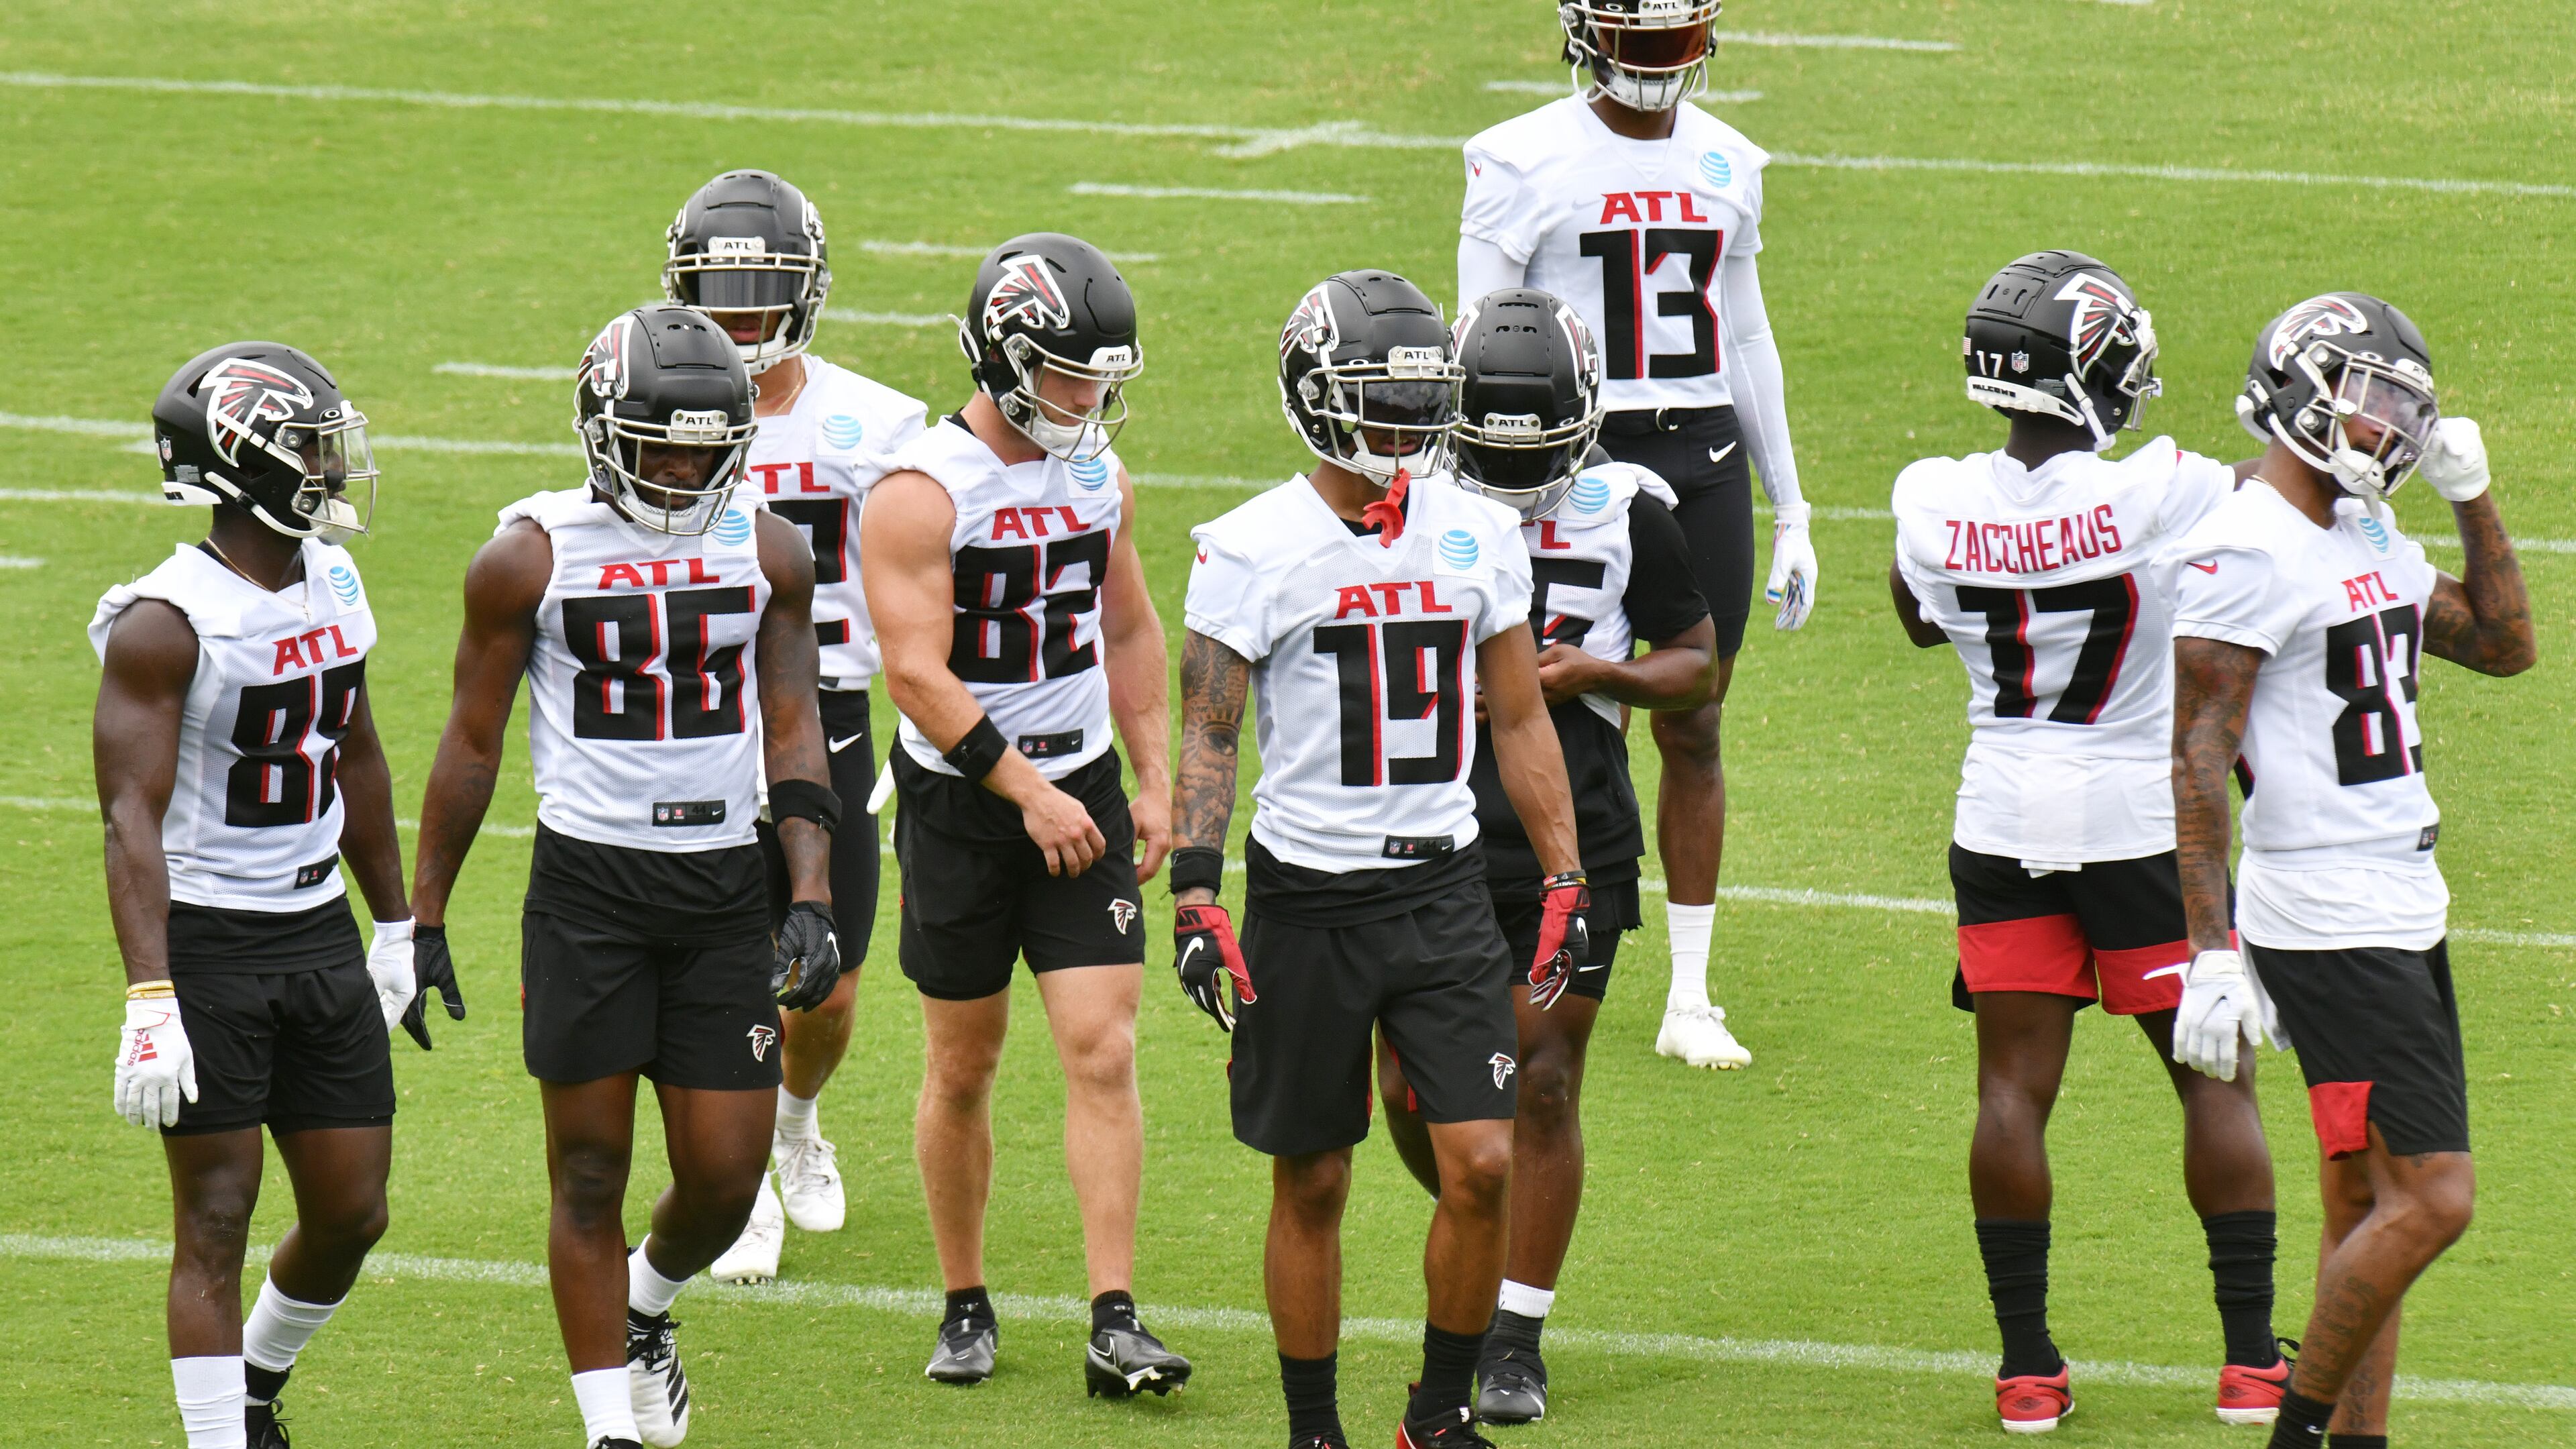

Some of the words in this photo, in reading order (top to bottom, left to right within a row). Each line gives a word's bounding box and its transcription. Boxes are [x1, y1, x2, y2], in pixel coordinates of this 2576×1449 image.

[1653, 2, 1678, 11] ATL
[1601, 191, 1707, 224] ATL
[724, 241, 751, 250] ATL
[1580, 229, 1723, 380] 13
[1106, 354, 1126, 363] ATL
[1404, 351, 1429, 360] ATL
[1976, 350, 2002, 378] 17
[686, 417, 712, 425] ATL
[1498, 419, 1527, 427] ATL
[749, 462, 830, 494] TL
[991, 506, 1091, 540] ATL
[1945, 504, 2121, 574] ZACCHEAUS
[597, 557, 720, 590] ATL
[946, 528, 1111, 684] 82
[1334, 581, 1452, 619] ATL
[2341, 571, 2398, 612] ATL
[272, 625, 358, 676] ATL
[561, 585, 755, 741] 86
[1313, 619, 1469, 787] 19
